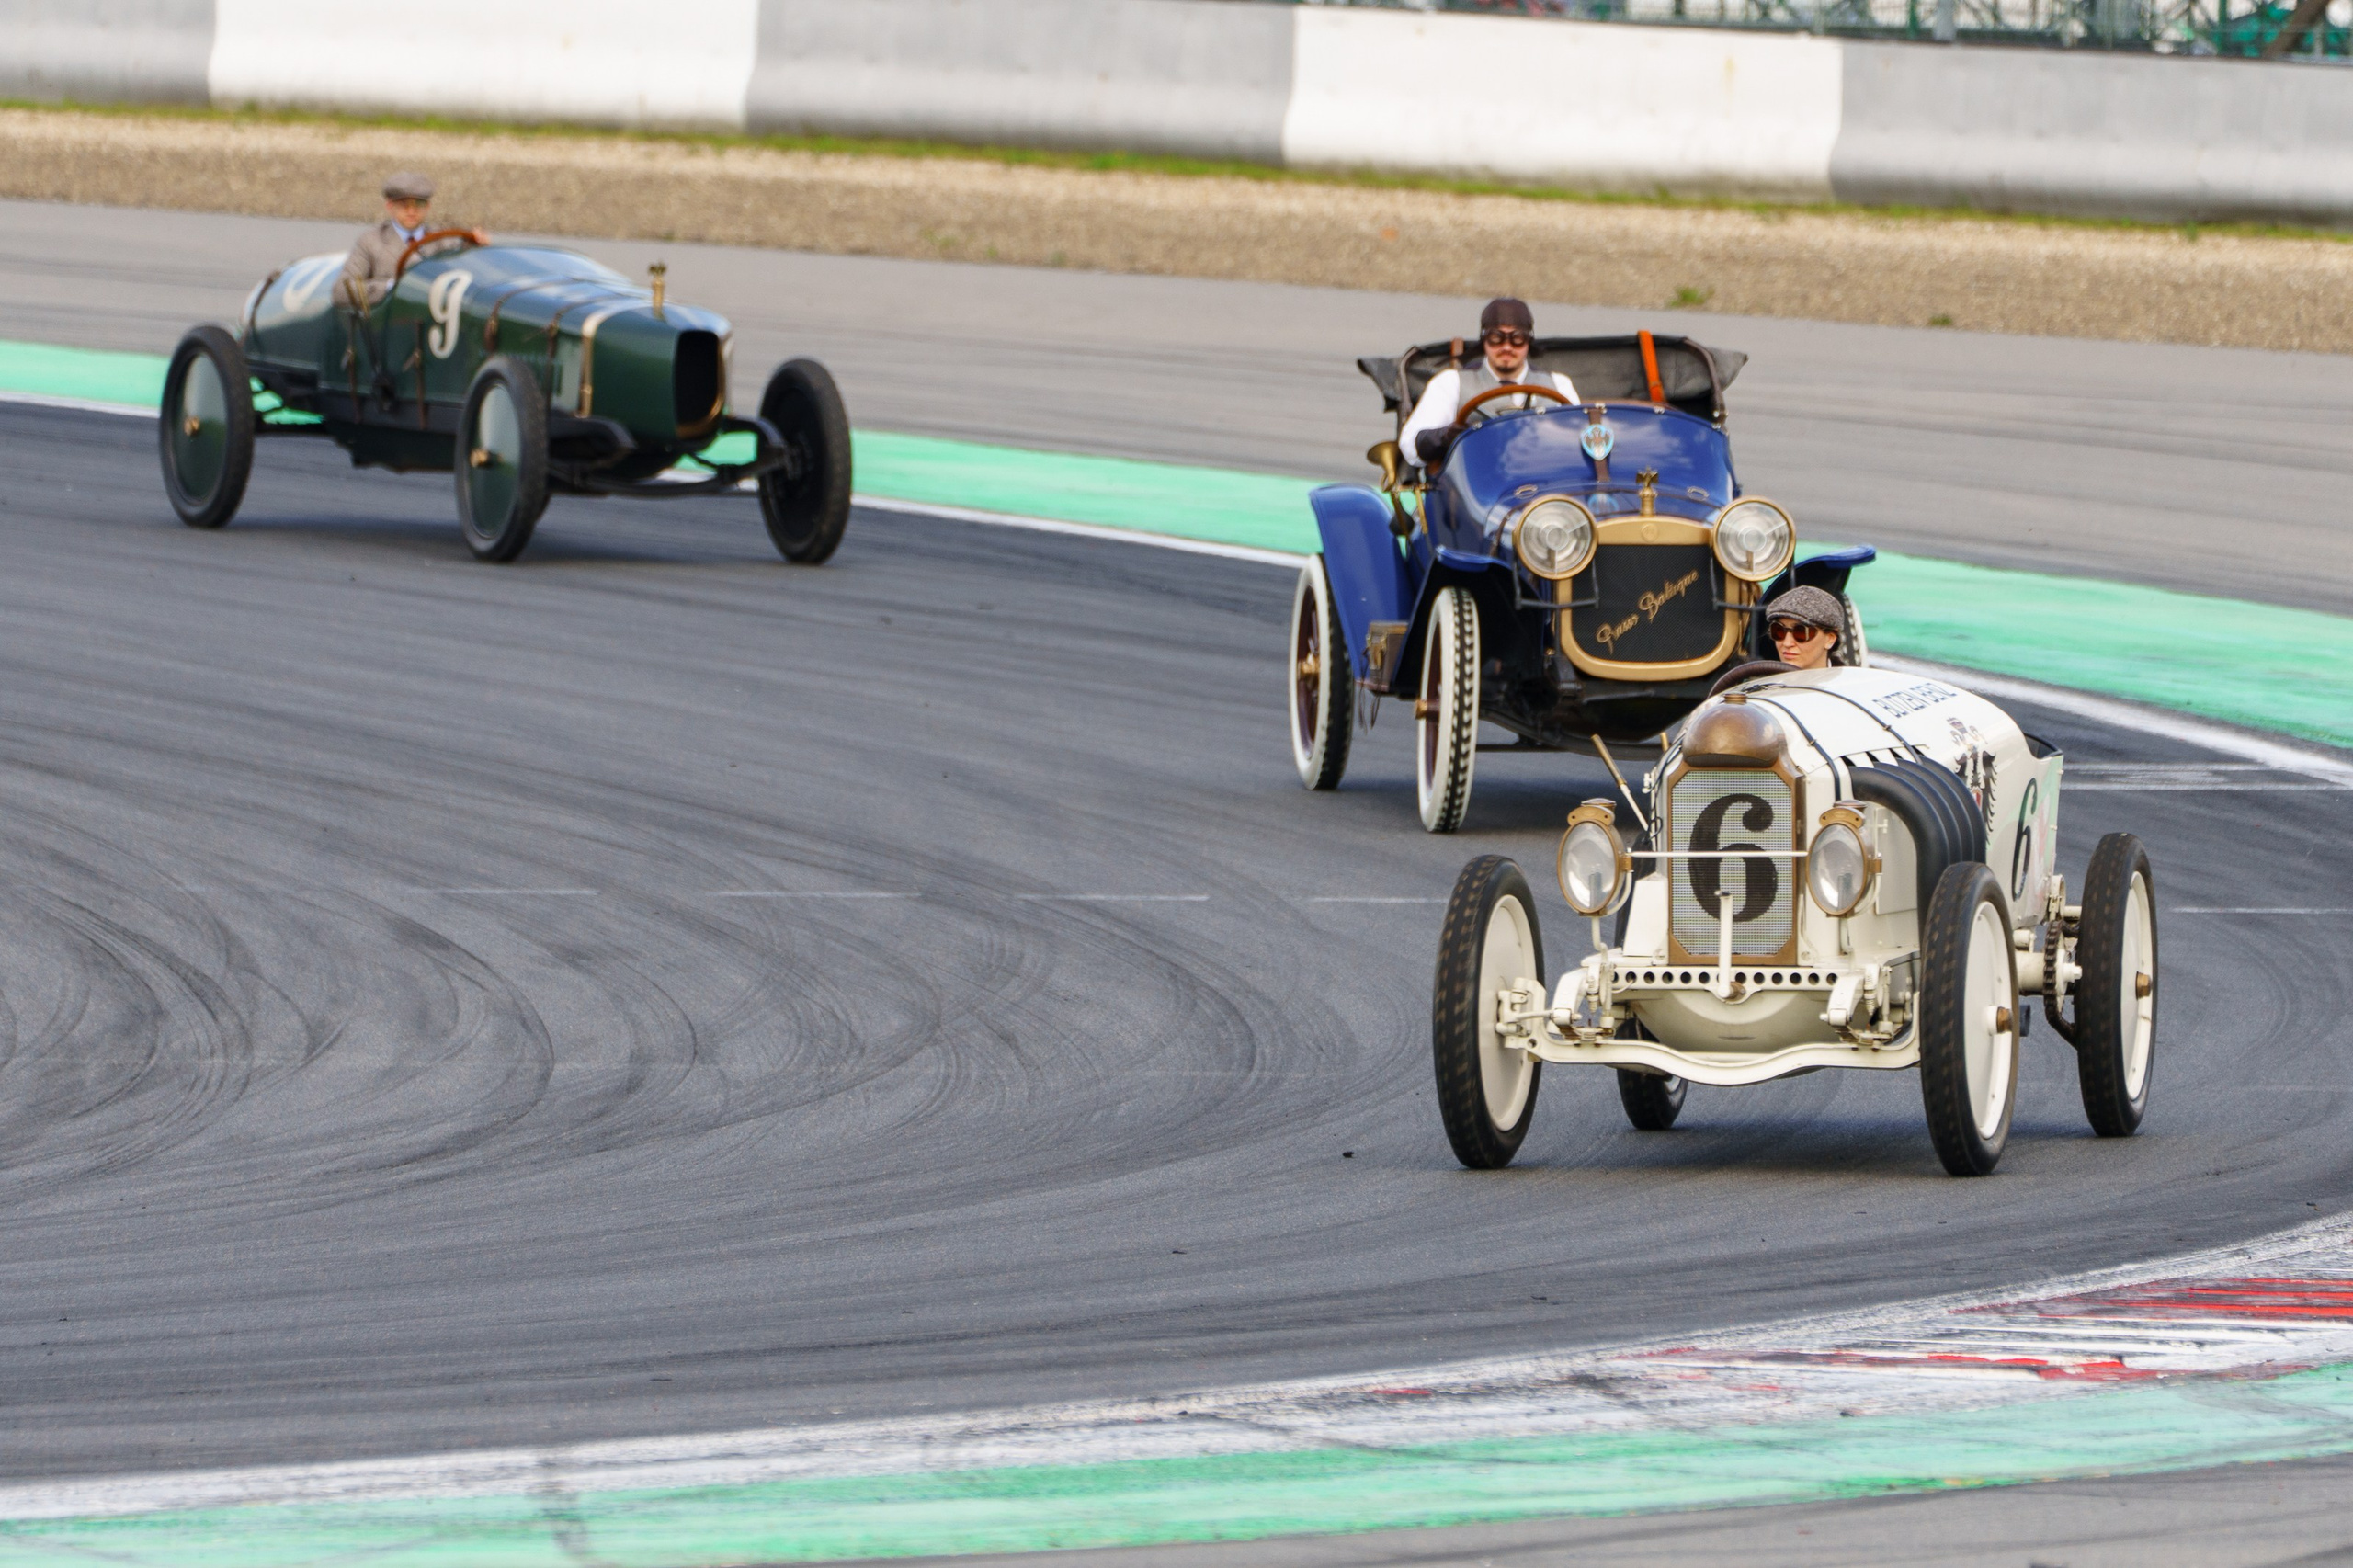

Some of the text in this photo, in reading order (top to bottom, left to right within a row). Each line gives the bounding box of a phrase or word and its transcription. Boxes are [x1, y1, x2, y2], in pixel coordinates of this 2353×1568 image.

[429, 269, 473, 358] 9
[1639, 569, 1699, 624] Baltique
[1688, 793, 1778, 922] 6
[2011, 778, 2038, 902] 6
